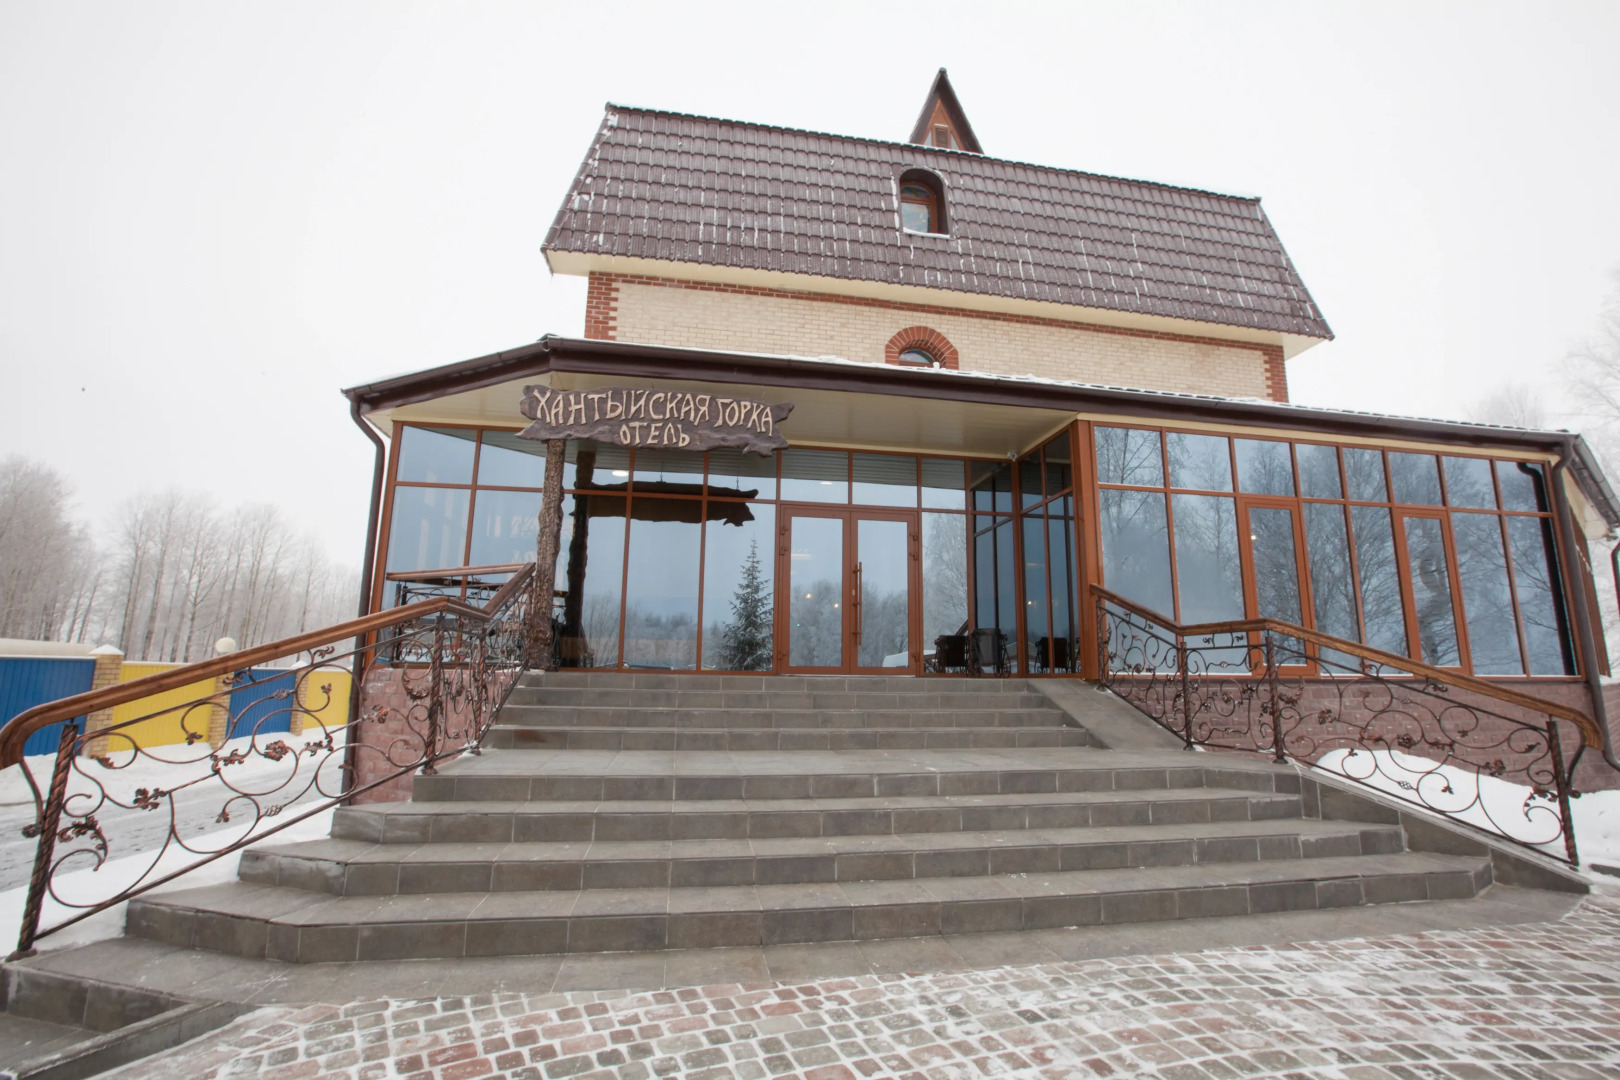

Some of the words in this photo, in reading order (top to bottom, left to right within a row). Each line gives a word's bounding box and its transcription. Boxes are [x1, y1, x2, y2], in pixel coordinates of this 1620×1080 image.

[533, 389, 711, 426] ХАНТЫЙСКАЯ
[714, 398, 773, 436] ГОРКА
[619, 421, 690, 447] ОТЕЛЬ
